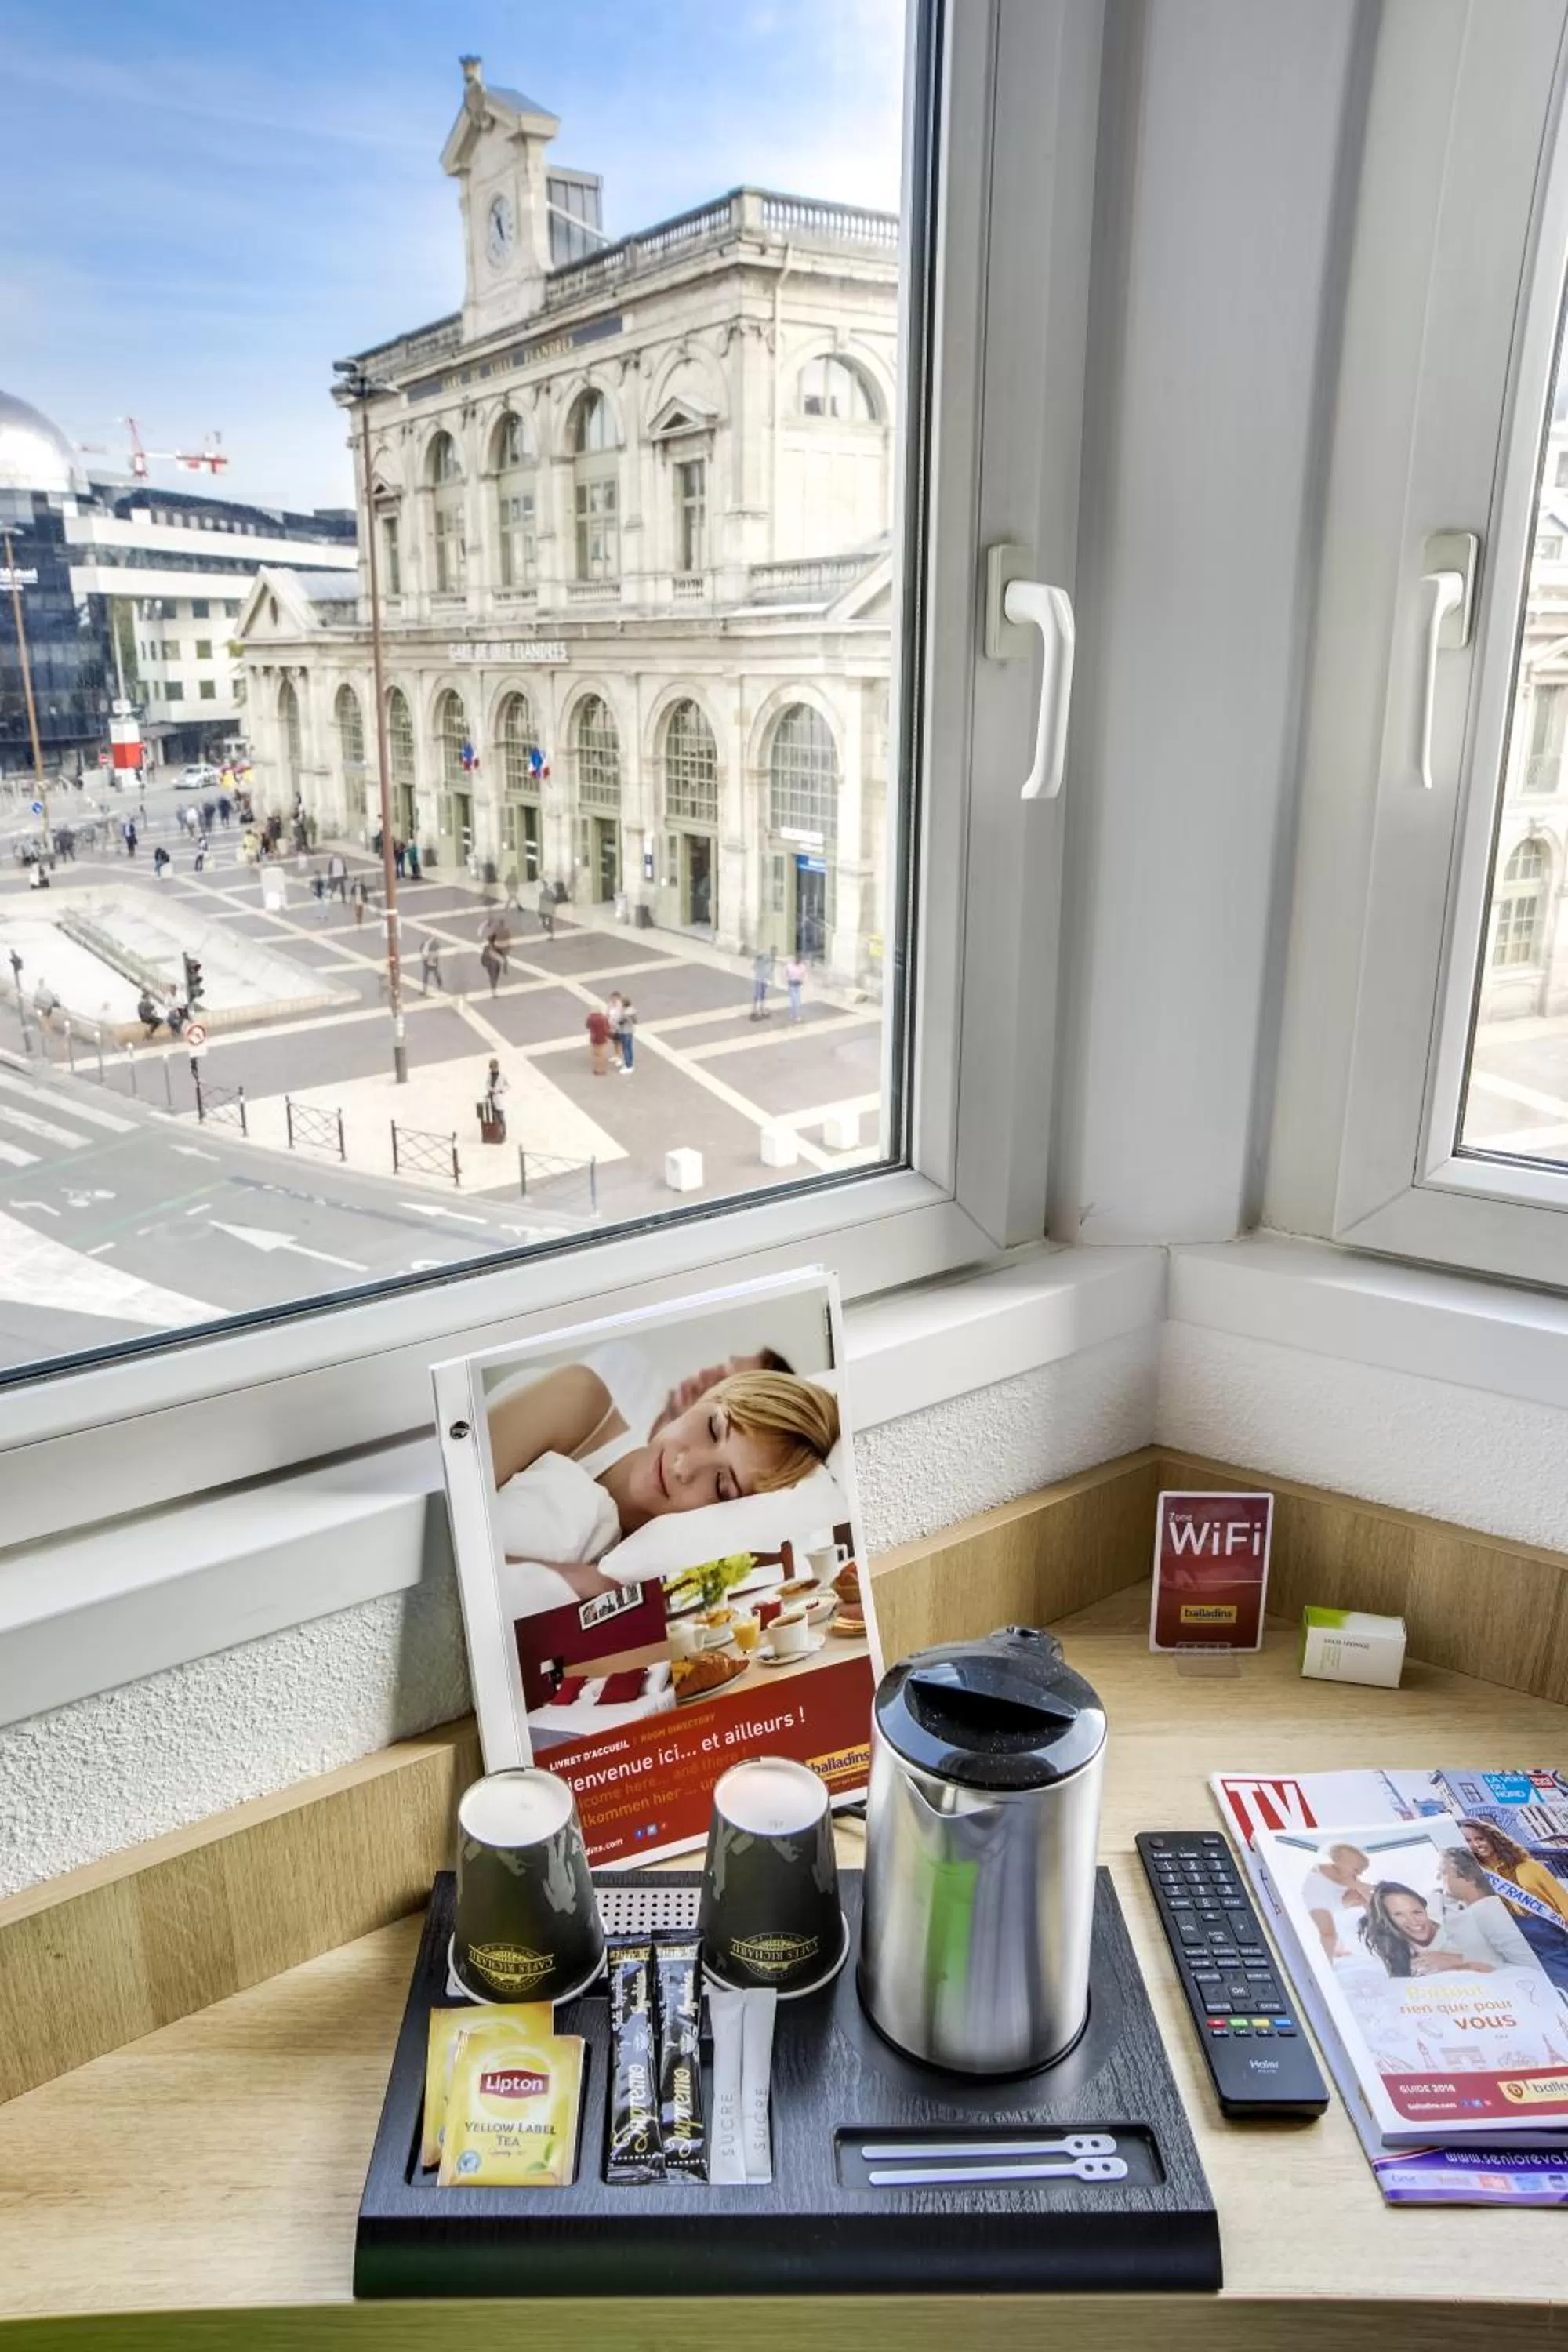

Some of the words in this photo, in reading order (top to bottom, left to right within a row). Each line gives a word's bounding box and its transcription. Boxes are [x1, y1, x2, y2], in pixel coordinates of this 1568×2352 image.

[1169, 1522, 1261, 1556] WiFi
[1184, 1607, 1233, 1617] balladins
[667, 1713, 717, 1736] DIRECTORY
[549, 1755, 582, 1772] LIVRET
[583, 1740, 630, 1762] D'ACCUEIL
[567, 1755, 654, 1792] ienvenue
[658, 1744, 697, 1766] ici...
[702, 1733, 720, 1751] et
[724, 1713, 794, 1745] ailleurs
[797, 1705, 806, 1723] !
[577, 1787, 622, 1810] lcome
[1223, 1780, 1312, 1835] TV
[581, 1797, 650, 1829] lkommen
[585, 1838, 624, 1856] dins.com
[1497, 1882, 1548, 1914] FRANCE
[1436, 2004, 1469, 2016] que
[1473, 2000, 1513, 2013] pour
[485, 2075, 544, 2093] Lipton
[1399, 2085, 1432, 2094] GUIDE
[1532, 2081, 1568, 2093] balla
[613, 2064, 659, 2153] Supremo
[663, 2068, 704, 2158] Supremo
[753, 2088, 768, 2153] SUCRE
[465, 2121, 514, 2135] YELLOW
[518, 2122, 557, 2136] LABEL
[720, 2094, 735, 2157] SUCRE
[495, 2134, 521, 2147] TEA
